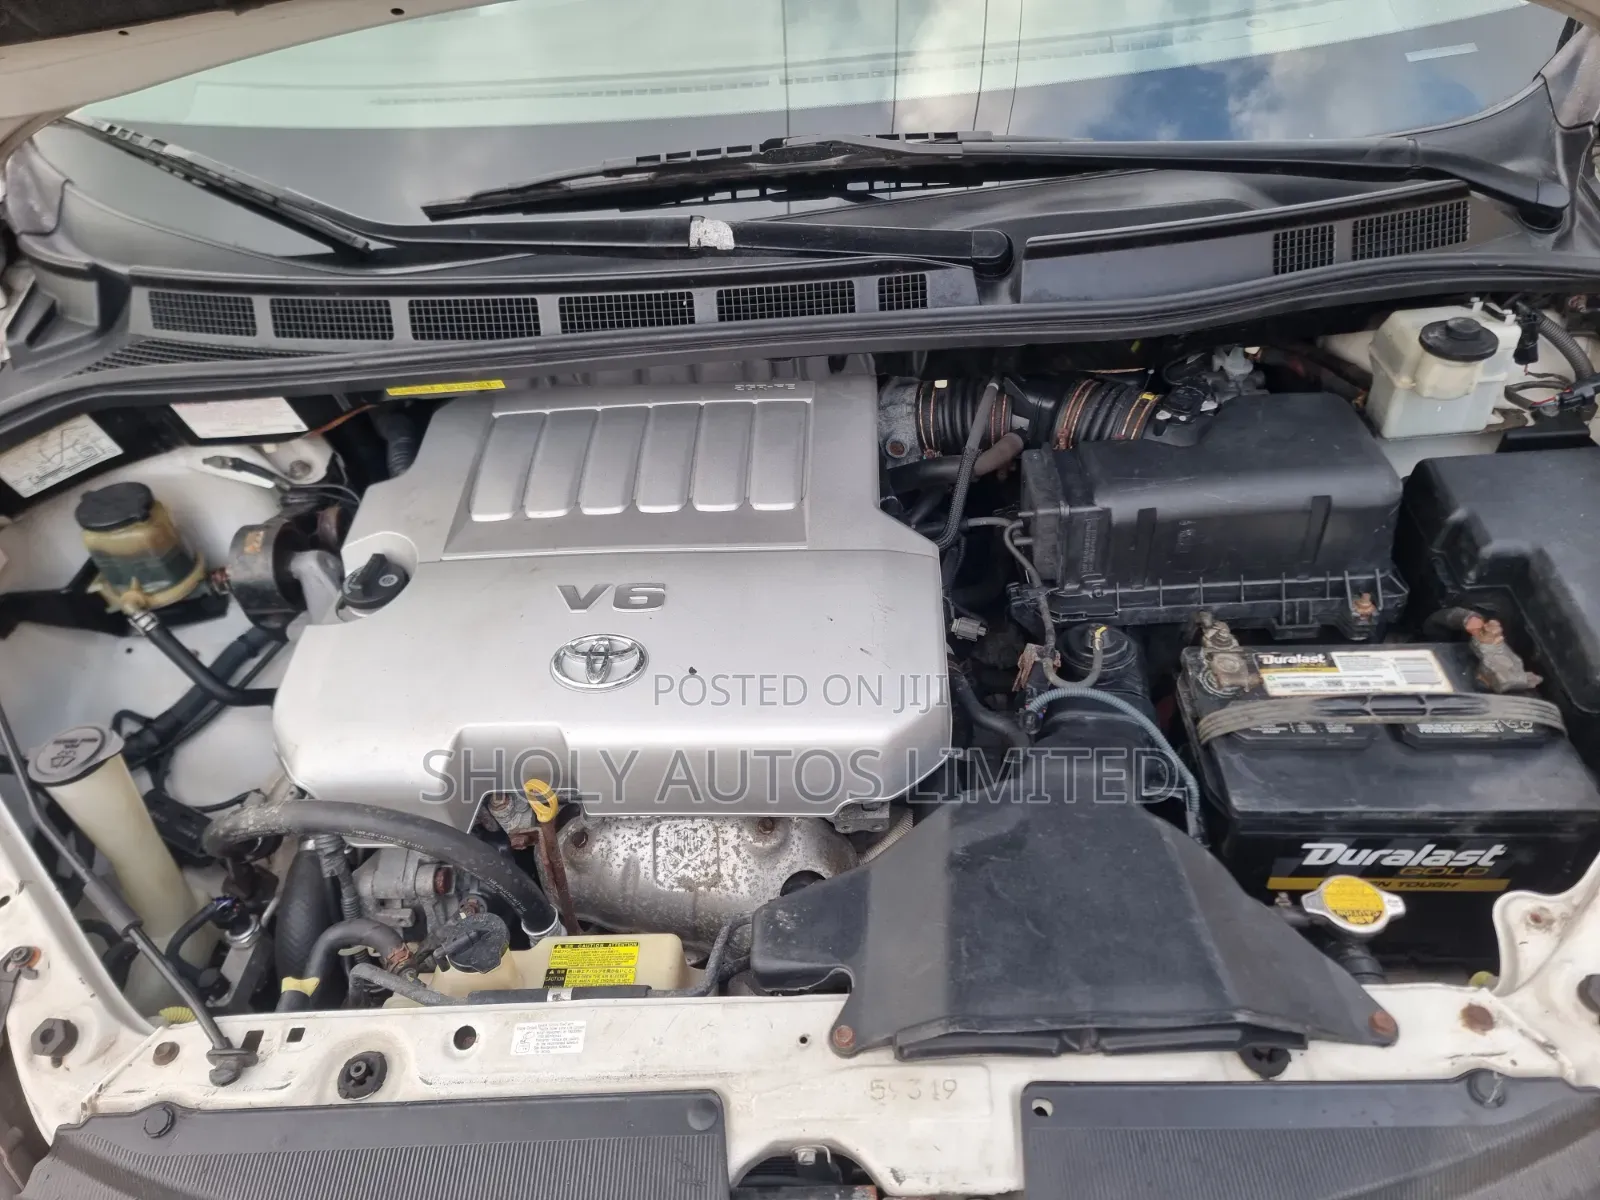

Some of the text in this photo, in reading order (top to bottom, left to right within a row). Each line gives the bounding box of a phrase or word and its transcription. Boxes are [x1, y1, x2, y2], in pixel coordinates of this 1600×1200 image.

[555, 582, 666, 613] V6
[1258, 653, 1326, 665] Duralast
[1301, 843, 1508, 867] Duralast
[1400, 867, 1490, 876] GOLD
[1397, 881, 1460, 889] TOUGH
